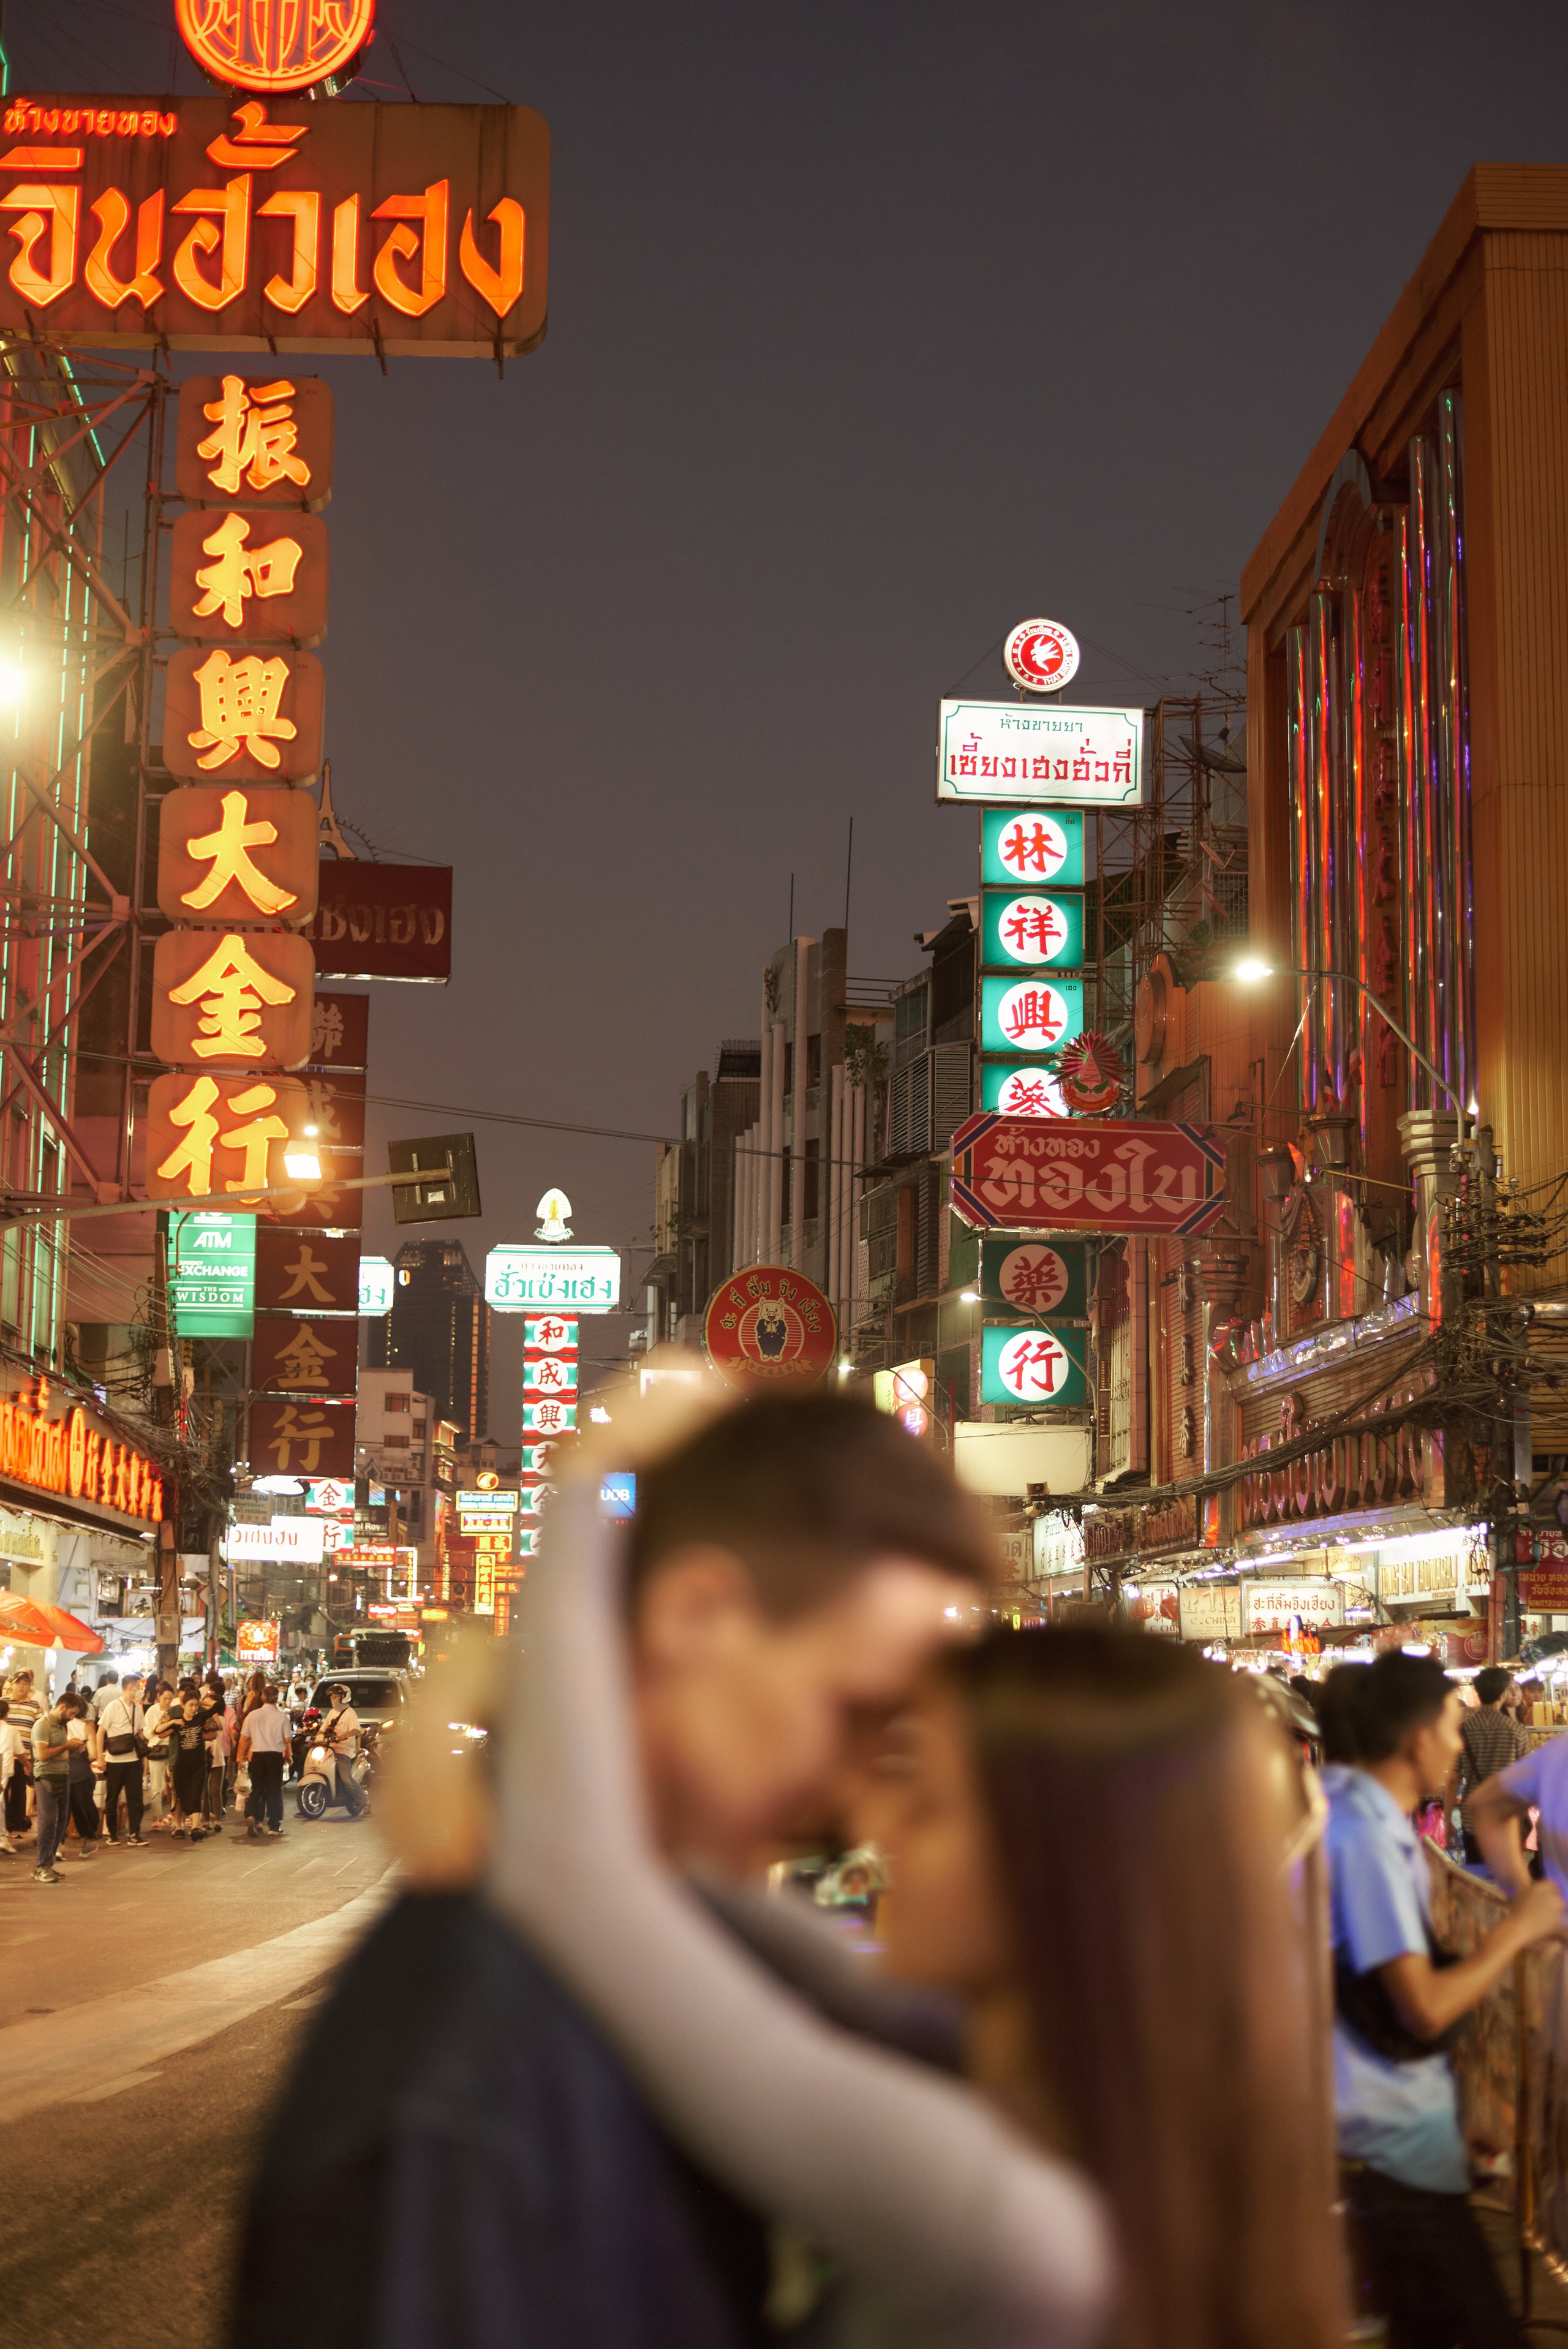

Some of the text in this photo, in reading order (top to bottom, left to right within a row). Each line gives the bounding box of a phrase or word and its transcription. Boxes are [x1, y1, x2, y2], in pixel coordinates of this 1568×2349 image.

[4, 98, 176, 137] ห้างขายทอง
[1000, 713, 1084, 733] ห้างขายยา
[994, 1126, 1100, 1159] ห้างทอง
[981, 1139, 1197, 1215] ทองใบ
[193, 1231, 232, 1248] ATM
[179, 1265, 248, 1277] EXCHANGE
[176, 1292, 244, 1303] WISDOM
[601, 1488, 630, 1501] UOB
